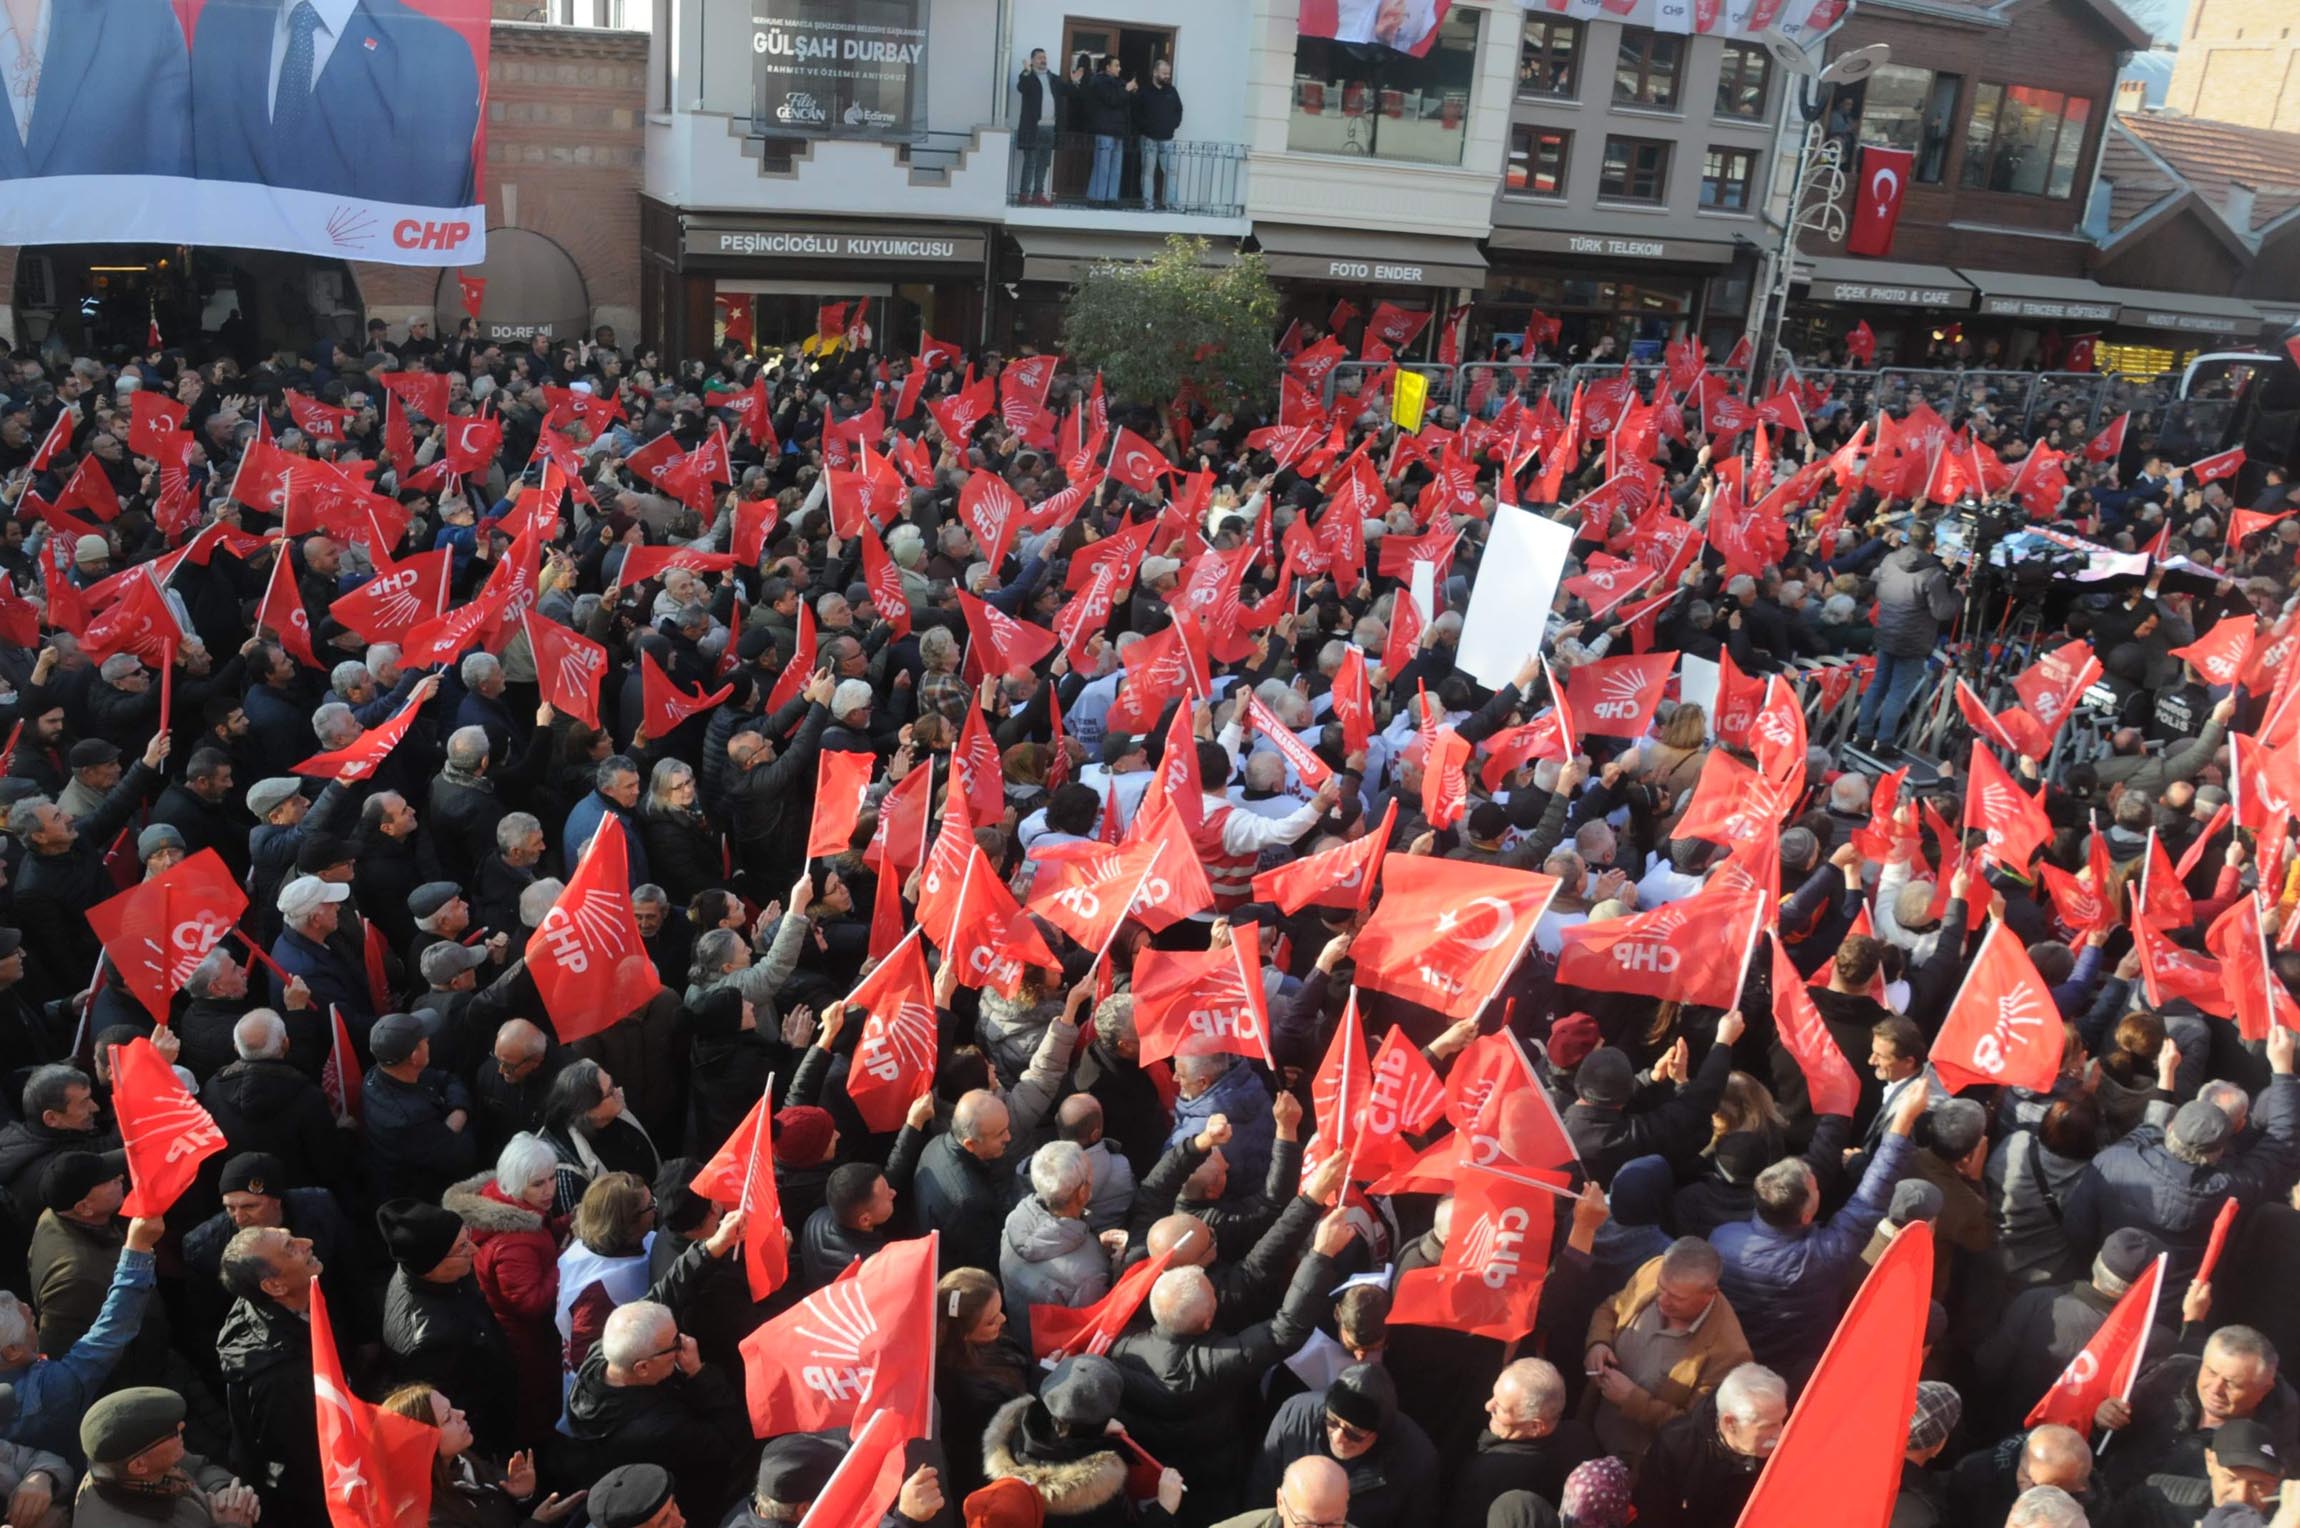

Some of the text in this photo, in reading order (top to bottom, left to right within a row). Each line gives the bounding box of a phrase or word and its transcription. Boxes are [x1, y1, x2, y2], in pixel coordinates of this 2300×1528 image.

[1663, 5, 1685, 16] CHP
[754, 28, 923, 65] GÜLŞAH DURBAY
[767, 64, 907, 82] RAHMET VE ÖZLEMLE ANIYORUZ
[864, 110, 896, 122] Edirne
[393, 219, 471, 250] CHP
[720, 233, 953, 256] PEŞİNCİOĞLU KUYUMCUSU
[1569, 236, 1663, 257] TÜRK TELEKOM
[1329, 262, 1422, 282] FOTO ENDER
[1834, 284, 1950, 304] ÇİÇEK PHOTO & CAFE
[1308, 354, 1334, 378] CHP
[1712, 414, 1740, 430] CHP
[367, 569, 418, 597] CHP
[957, 757, 976, 795] CH
[543, 906, 588, 975] CHP
[861, 1016, 899, 1082] CHP
